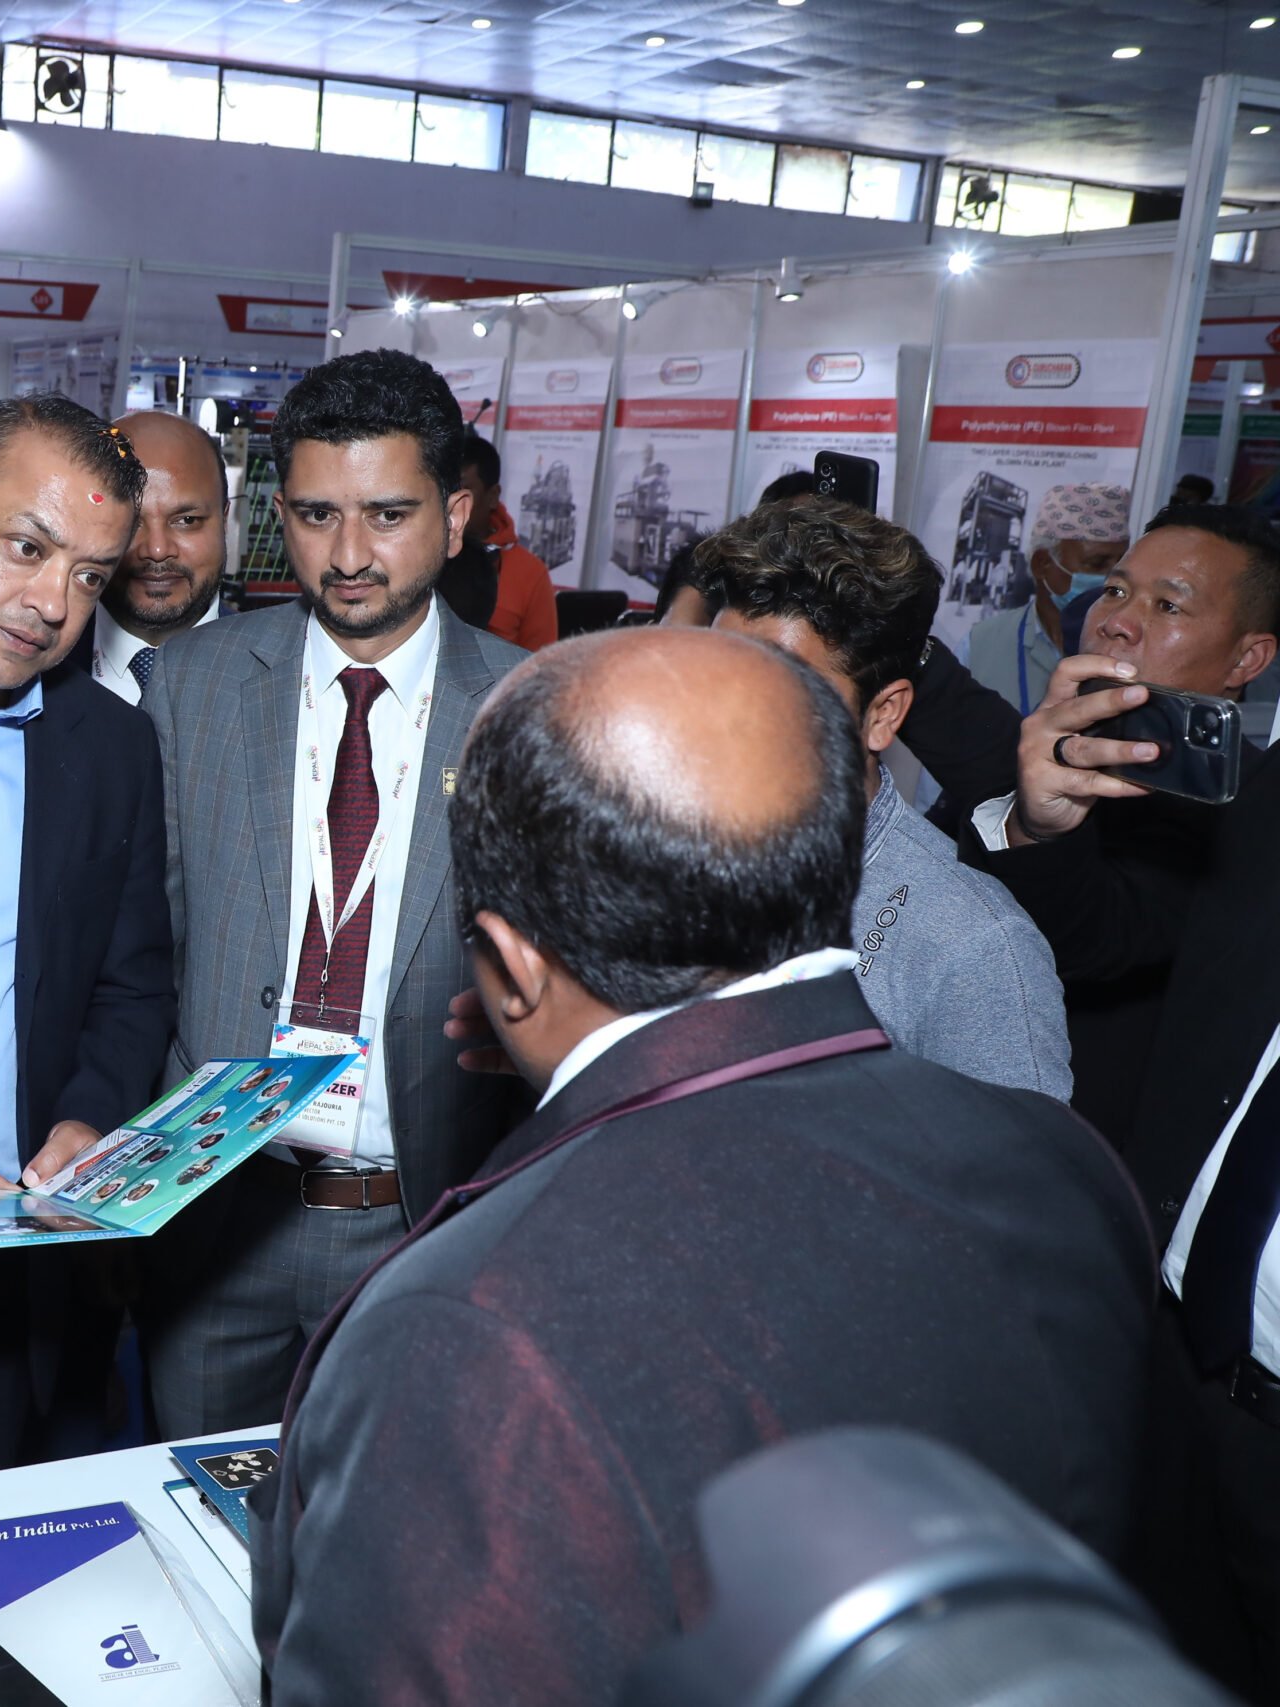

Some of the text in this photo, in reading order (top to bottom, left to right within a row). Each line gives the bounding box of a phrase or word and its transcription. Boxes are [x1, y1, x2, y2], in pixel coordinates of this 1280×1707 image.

[961, 420, 1022, 434] Polyethylene
[1023, 421, 1044, 433] (PE)
[297, 1040, 324, 1052] NEPAL
[312, 1101, 342, 1111] RAJOURIA
[13, 1520, 68, 1540] India
[70, 1521, 95, 1531] Pvt.
[95, 1516, 121, 1529] Ltd.
